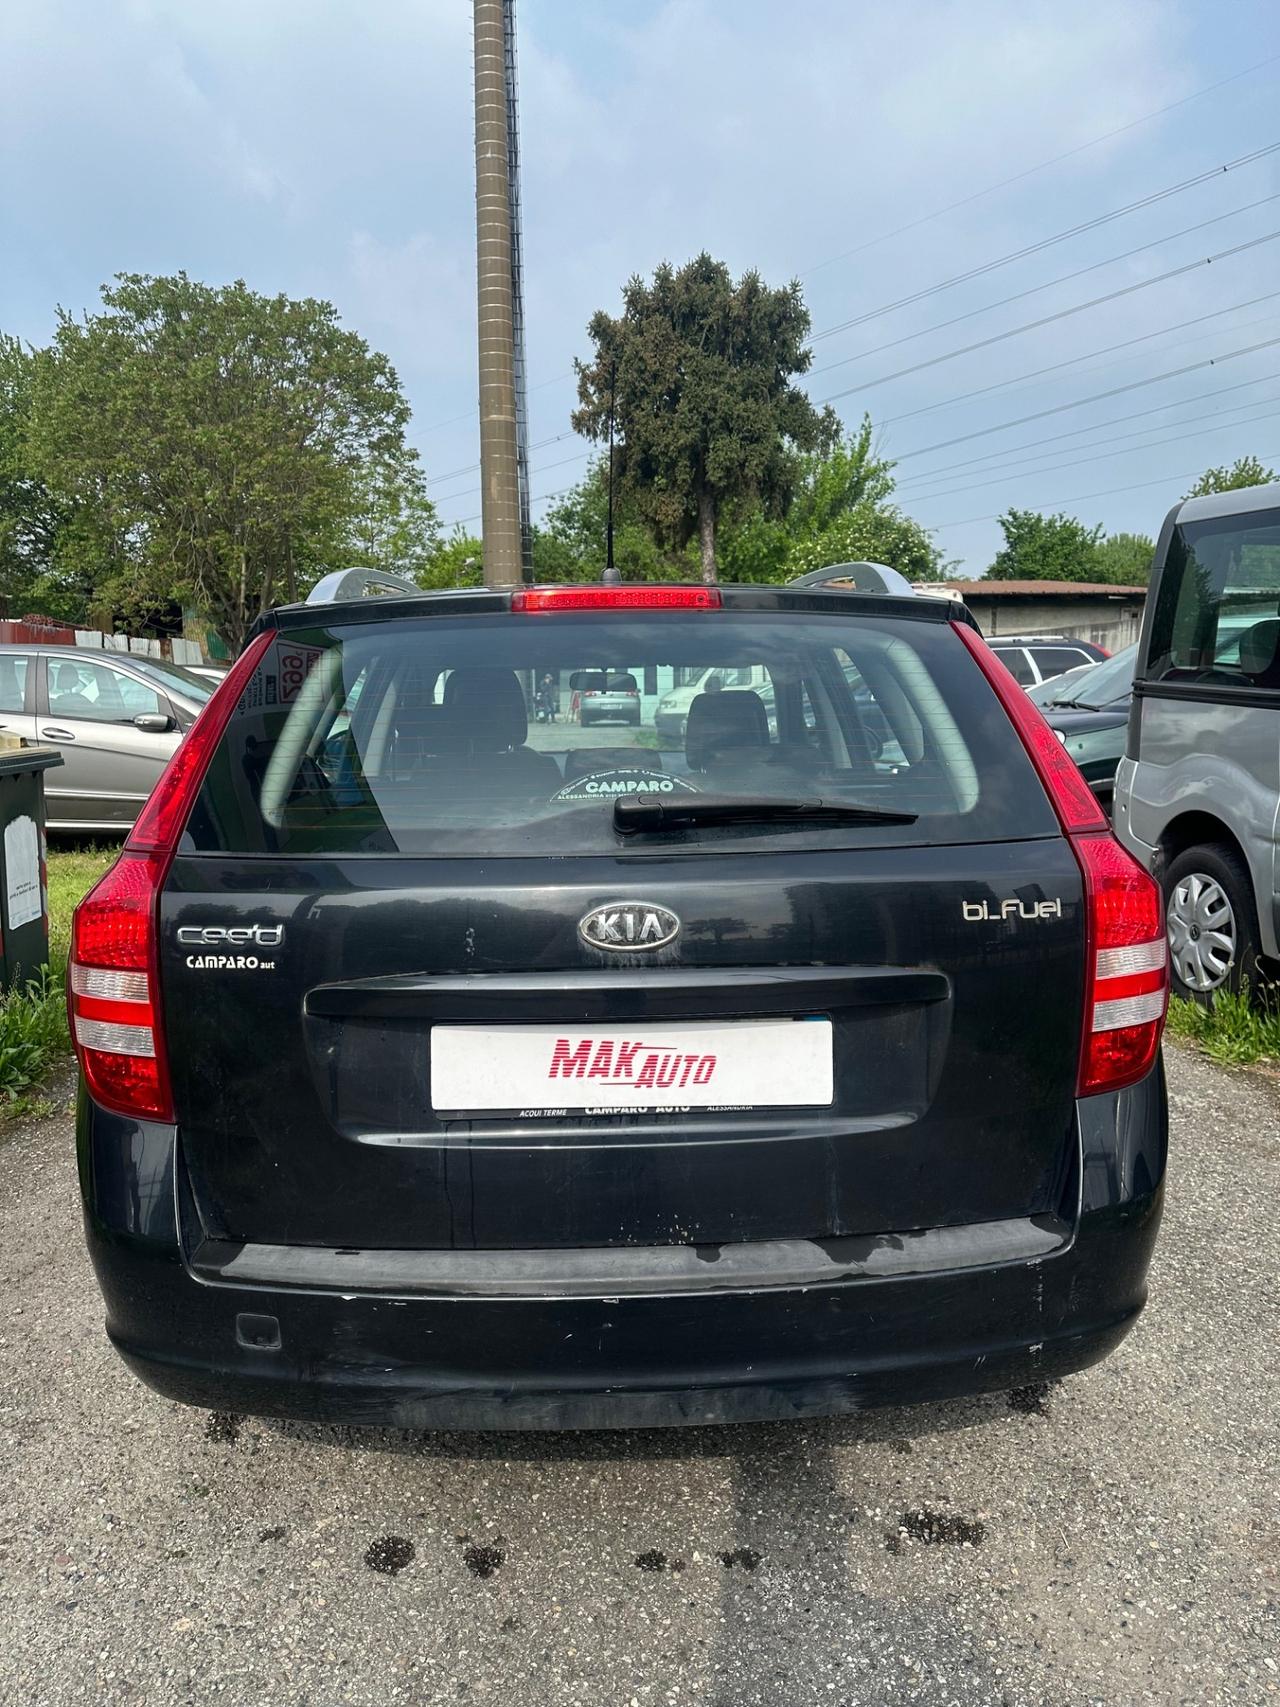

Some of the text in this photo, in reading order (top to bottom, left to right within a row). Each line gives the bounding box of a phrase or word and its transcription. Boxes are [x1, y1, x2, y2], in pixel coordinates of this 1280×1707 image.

[585, 780, 674, 793] CAMPARO
[597, 913, 665, 940] KIA
[186, 955, 275, 969] CAMPARO aut
[548, 1039, 717, 1088] MAK AUTO
[519, 1108, 568, 1117] ACQUI TERME
